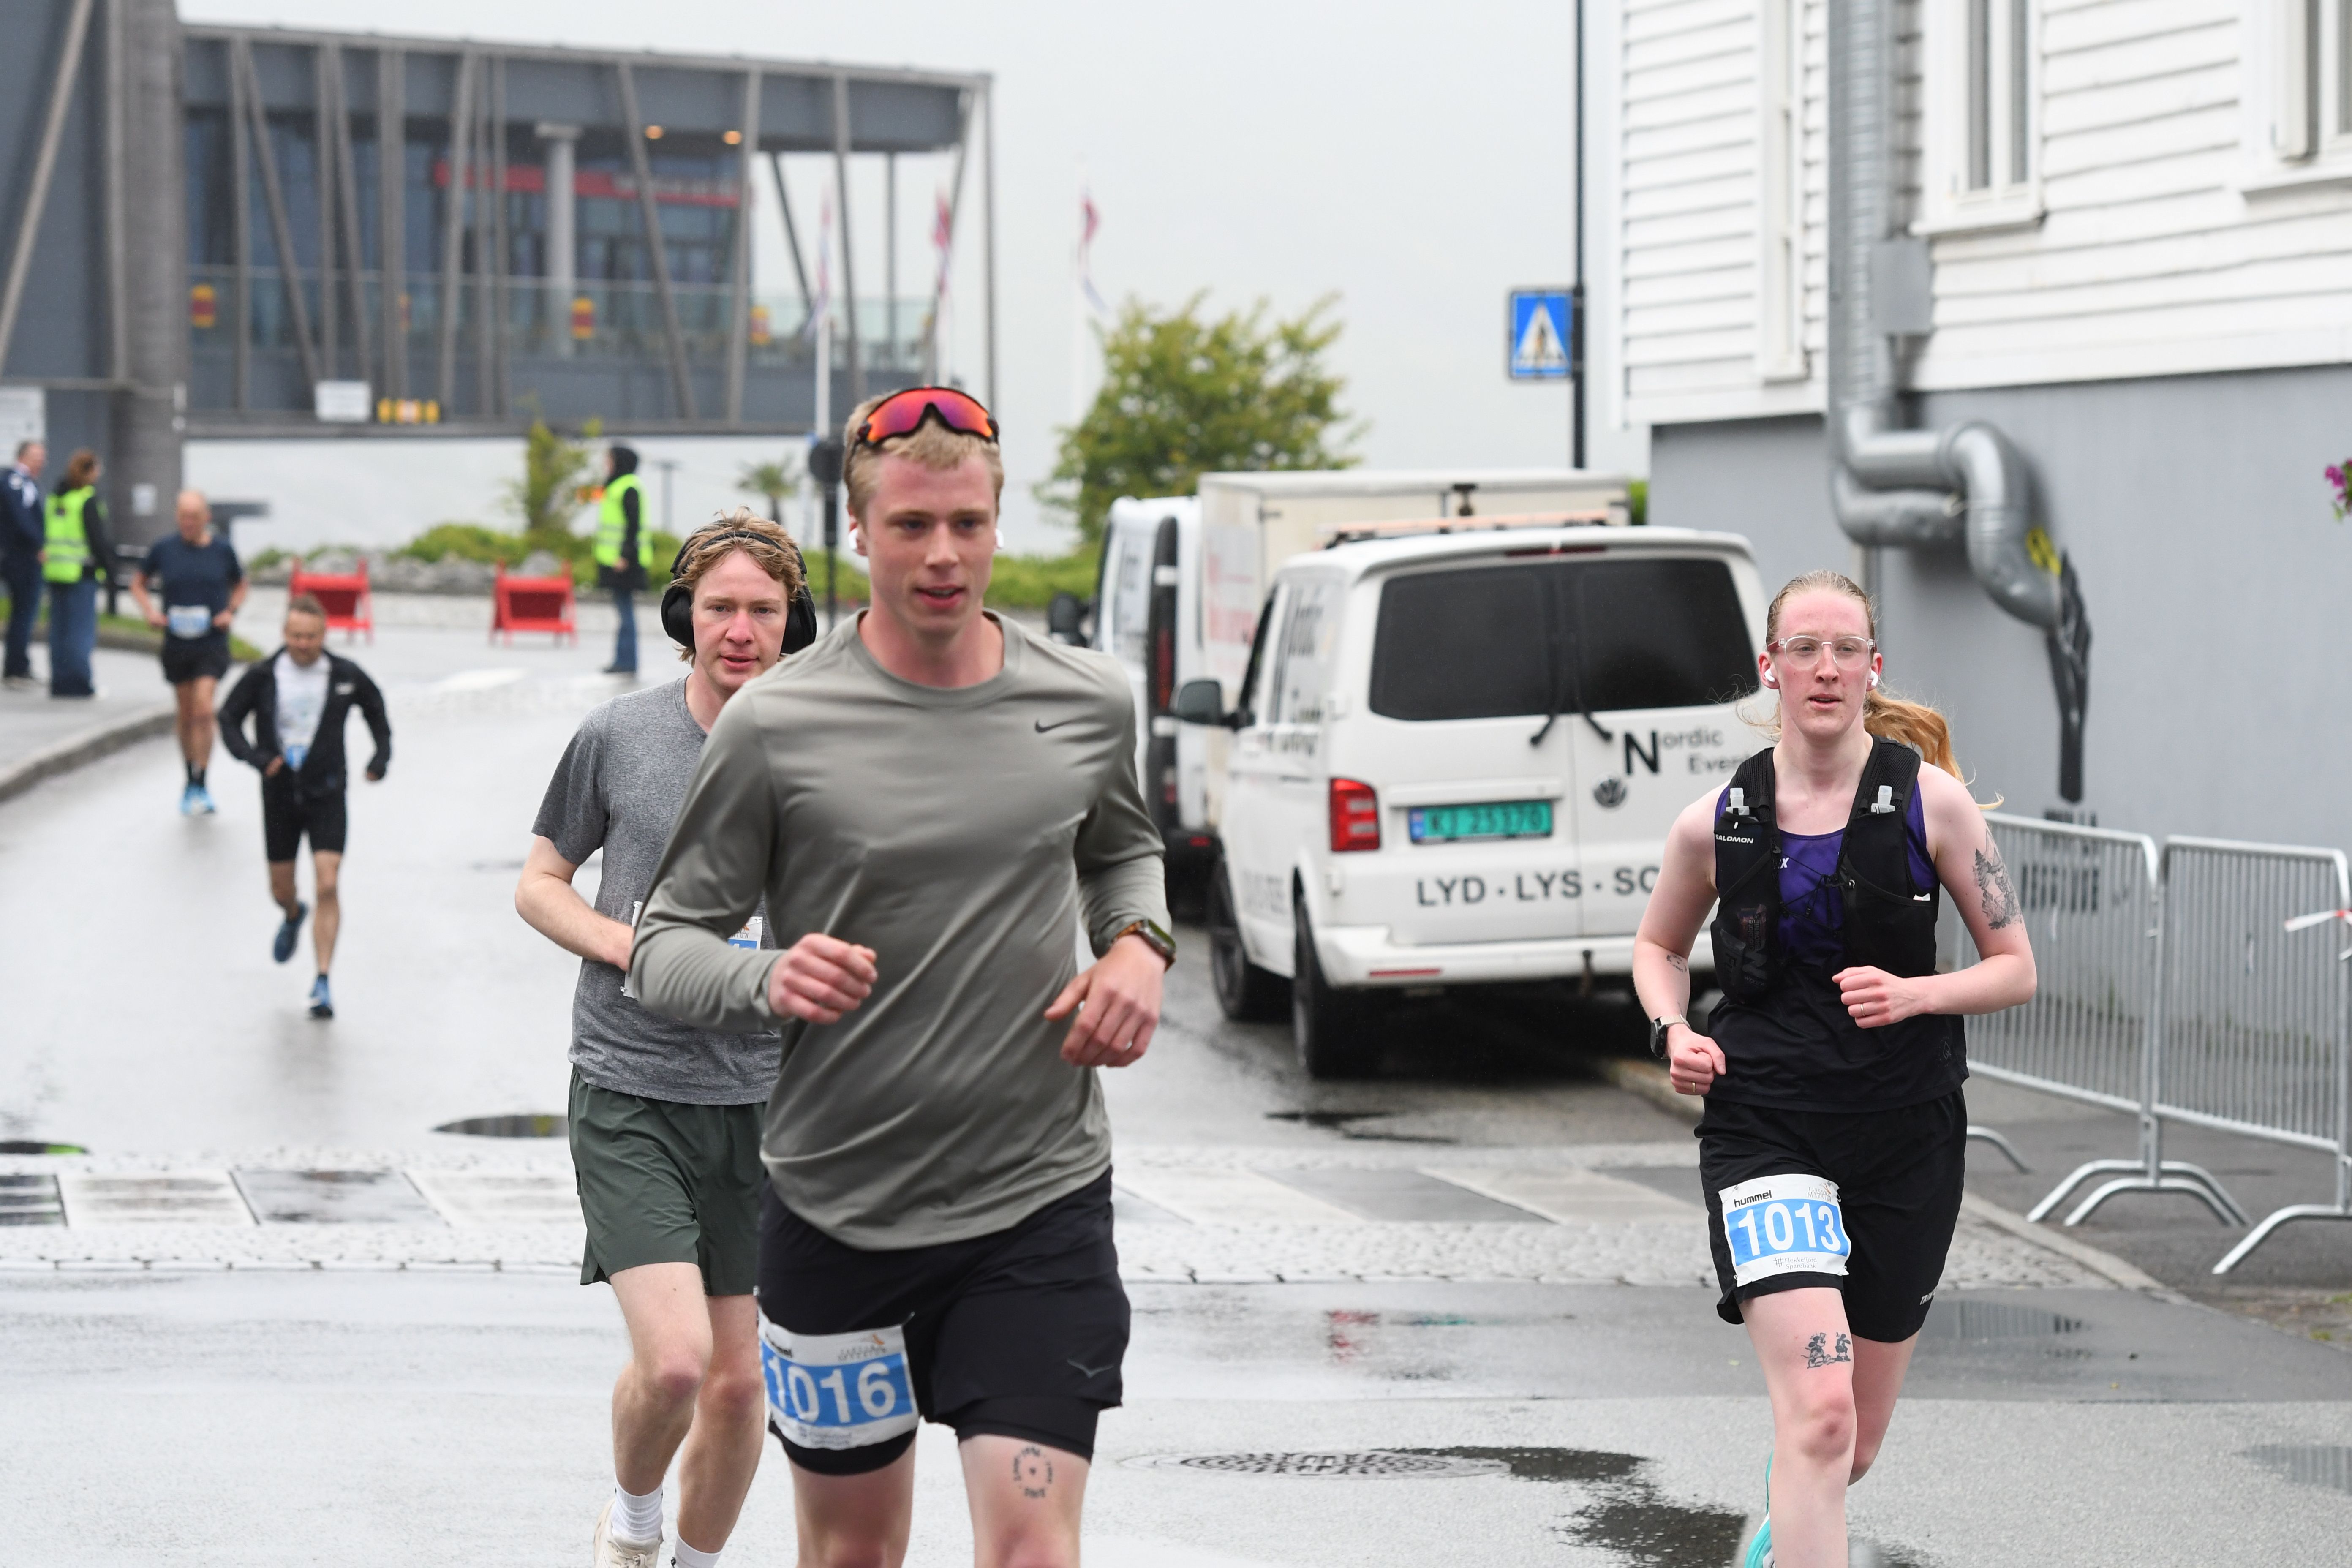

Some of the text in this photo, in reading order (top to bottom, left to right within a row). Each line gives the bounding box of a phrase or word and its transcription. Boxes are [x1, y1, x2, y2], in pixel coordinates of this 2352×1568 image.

[1624, 730, 1723, 775] Nordic
[1716, 834, 1754, 844] SALOMON
[1417, 865, 1661, 906] LYD LYS SC
[1734, 1190, 1772, 1208] hummel
[1738, 1202, 1841, 1256] 1013
[768, 1355, 896, 1424] 1016
